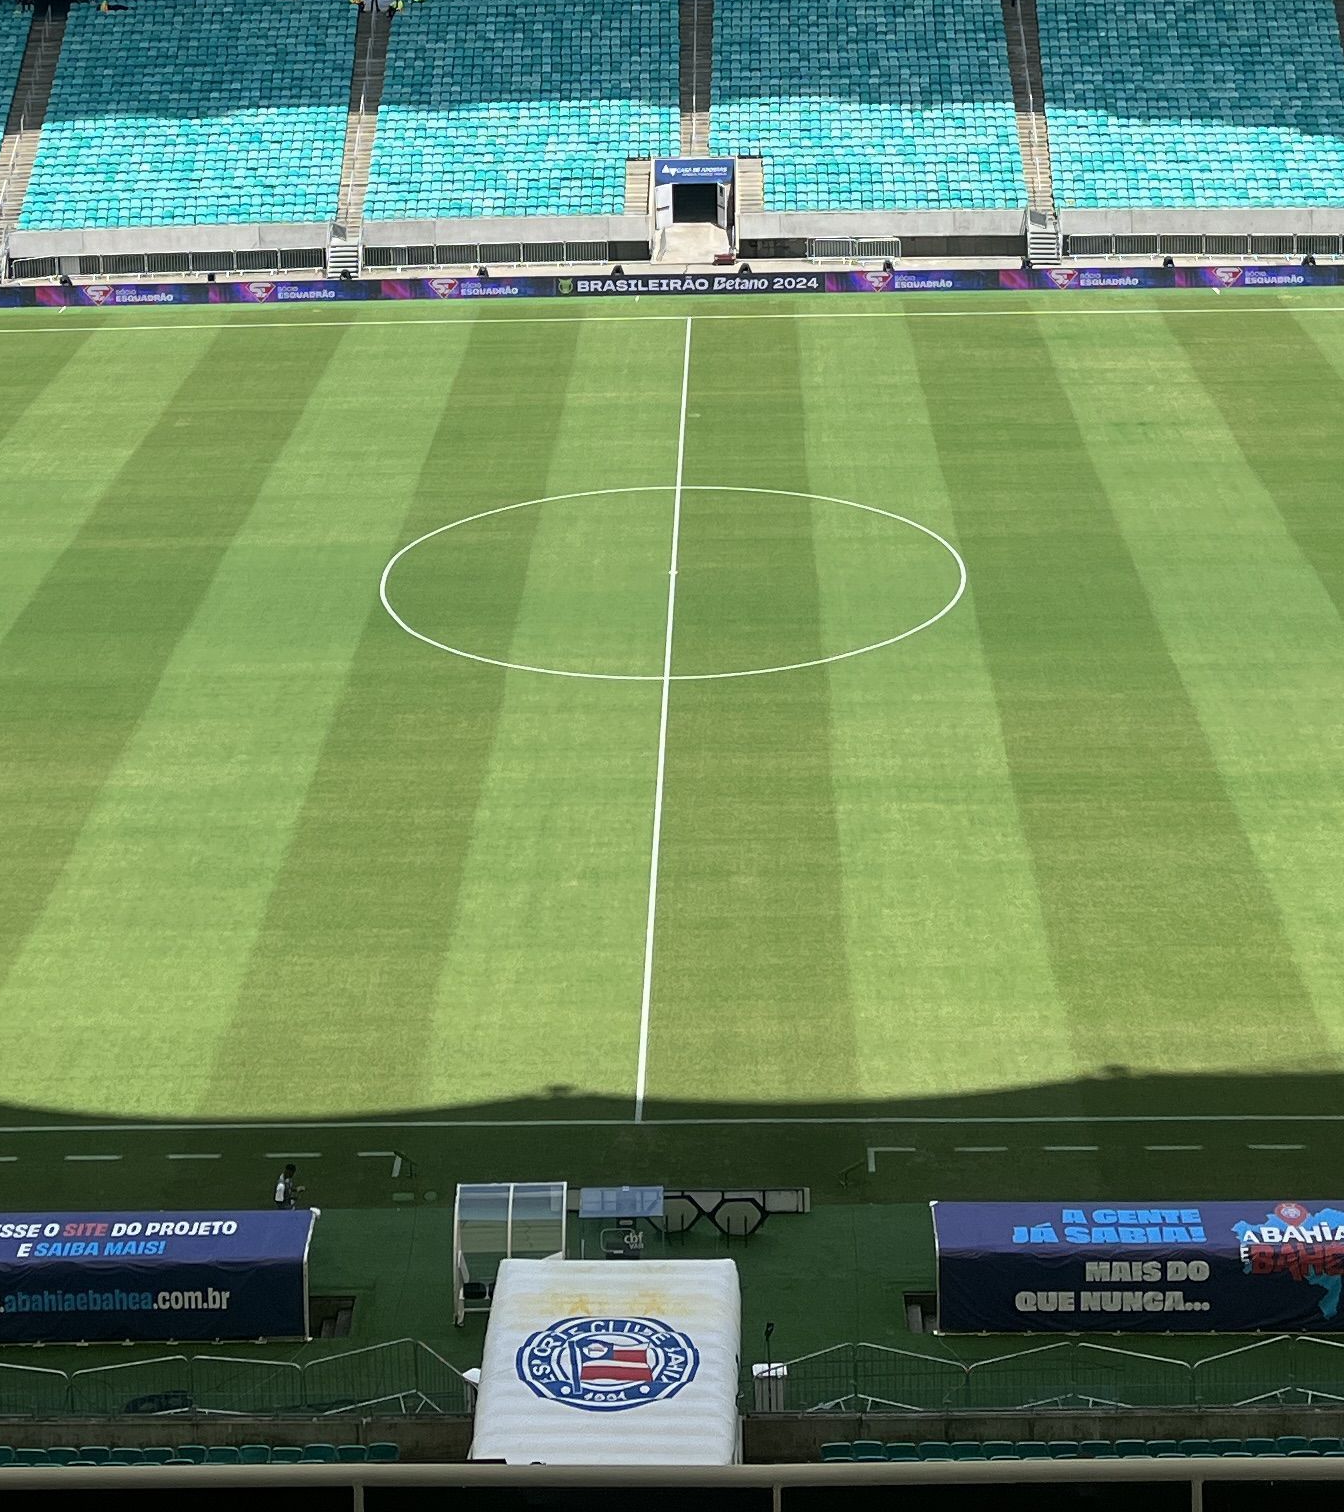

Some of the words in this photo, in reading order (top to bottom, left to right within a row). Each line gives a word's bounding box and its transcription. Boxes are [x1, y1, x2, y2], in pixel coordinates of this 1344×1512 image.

[577, 275, 710, 292] BRASILEIRÃO
[713, 277, 768, 291] Betano
[773, 278, 819, 289] 2024
[894, 279, 952, 288] ESQUADRÃO
[1080, 276, 1138, 286] ESQUADRÃO
[1244, 274, 1304, 284] ESQUADRÃO
[277, 290, 335, 299] ESQUADRÃO
[460, 286, 518, 295] ESQUADRÃO
[115, 294, 173, 303] ESQUADRÃO
[1062, 1209, 1087, 1224] A
[1092, 1208, 1203, 1224] GENTE
[43, 1222, 60, 1237] O
[63, 1222, 108, 1237] SITE
[110, 1221, 143, 1237] DO
[145, 1220, 238, 1236] PROJETO
[1012, 1221, 1059, 1244] JÁ
[1064, 1225, 1208, 1245] SABIA!
[624, 1231, 644, 1244] cbf
[1243, 1230, 1260, 1243] A
[16, 1243, 31, 1258] E
[34, 1241, 99, 1257] SAIBA
[104, 1240, 166, 1256] MAIS!
[1085, 1261, 1162, 1283] MAIS
[1166, 1260, 1210, 1282] DO
[1014, 1291, 1075, 1312] QUE
[1080, 1290, 1211, 1312] NUNCA...
